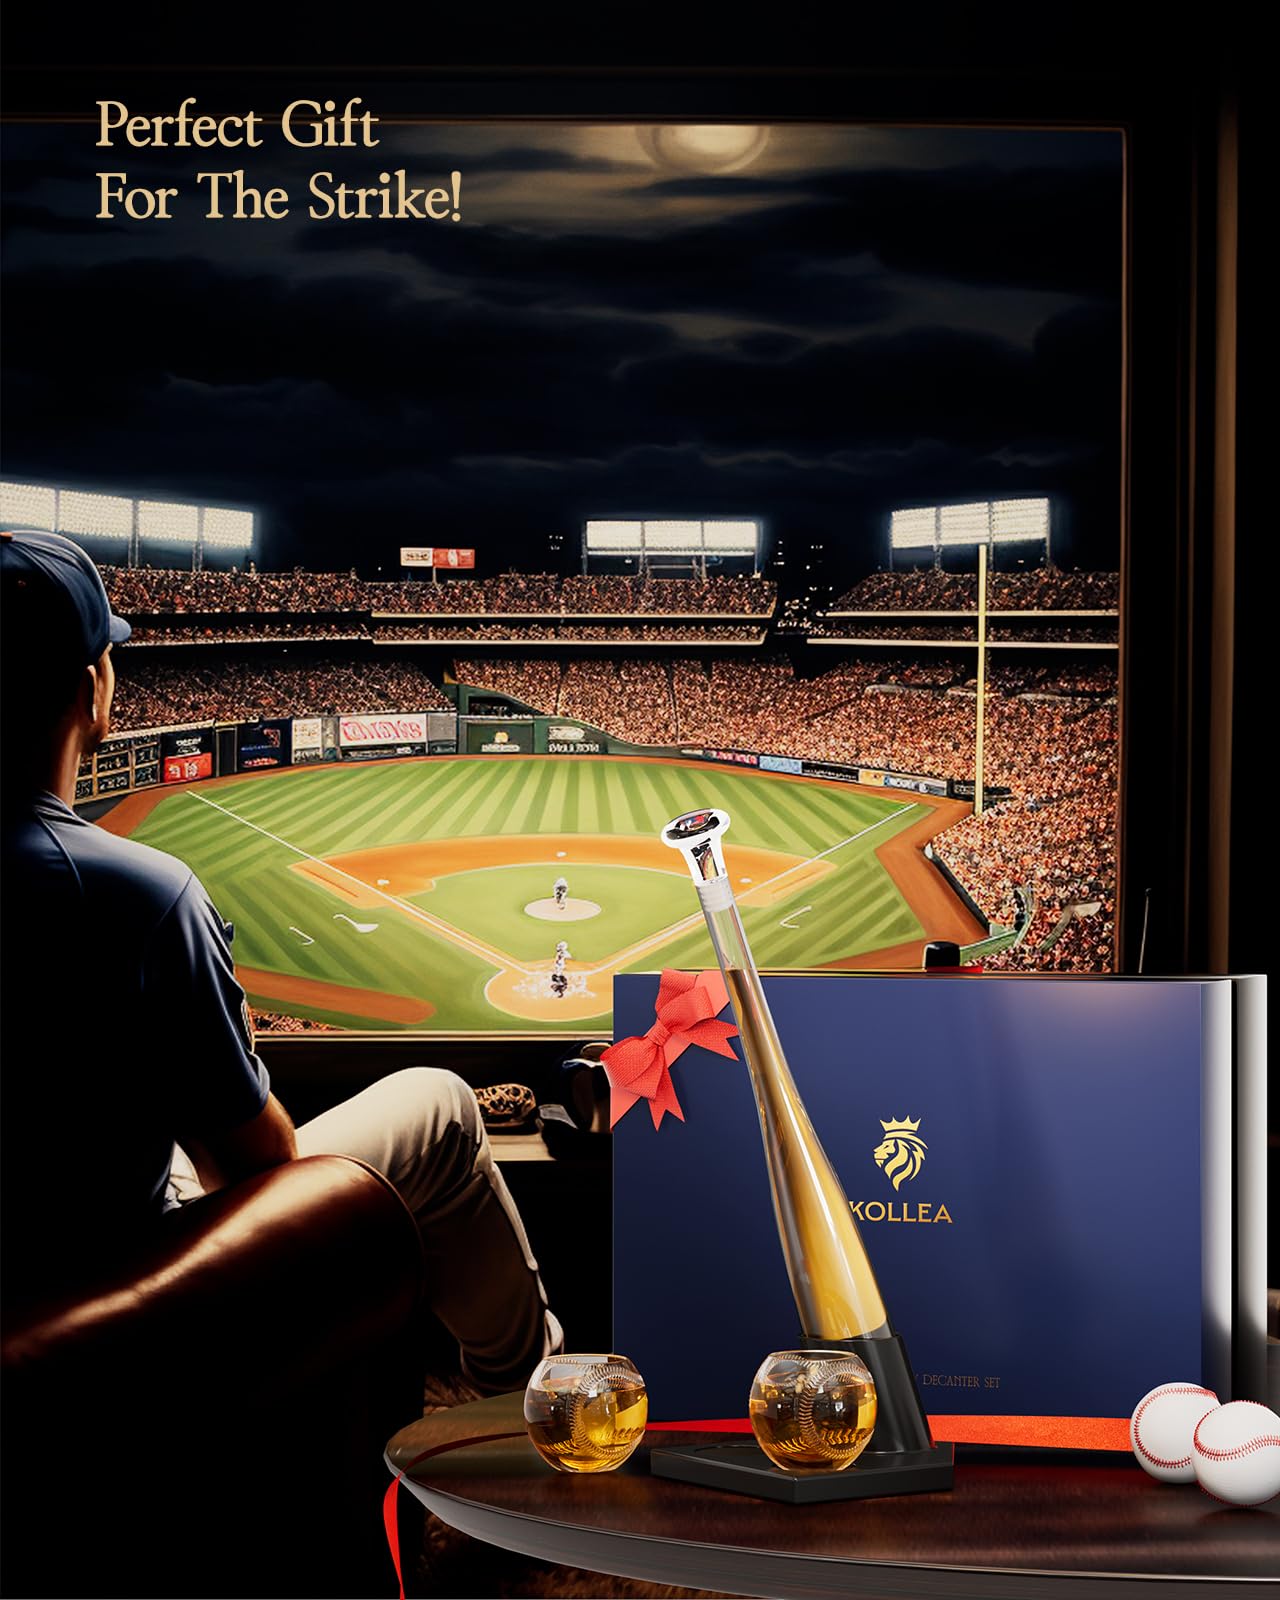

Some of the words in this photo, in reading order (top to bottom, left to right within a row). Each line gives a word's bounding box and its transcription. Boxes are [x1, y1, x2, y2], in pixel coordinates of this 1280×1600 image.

[848, 1200, 953, 1224] KOLLEA
[922, 1374, 980, 1388] DECANTER
[984, 1376, 1001, 1389] SET
